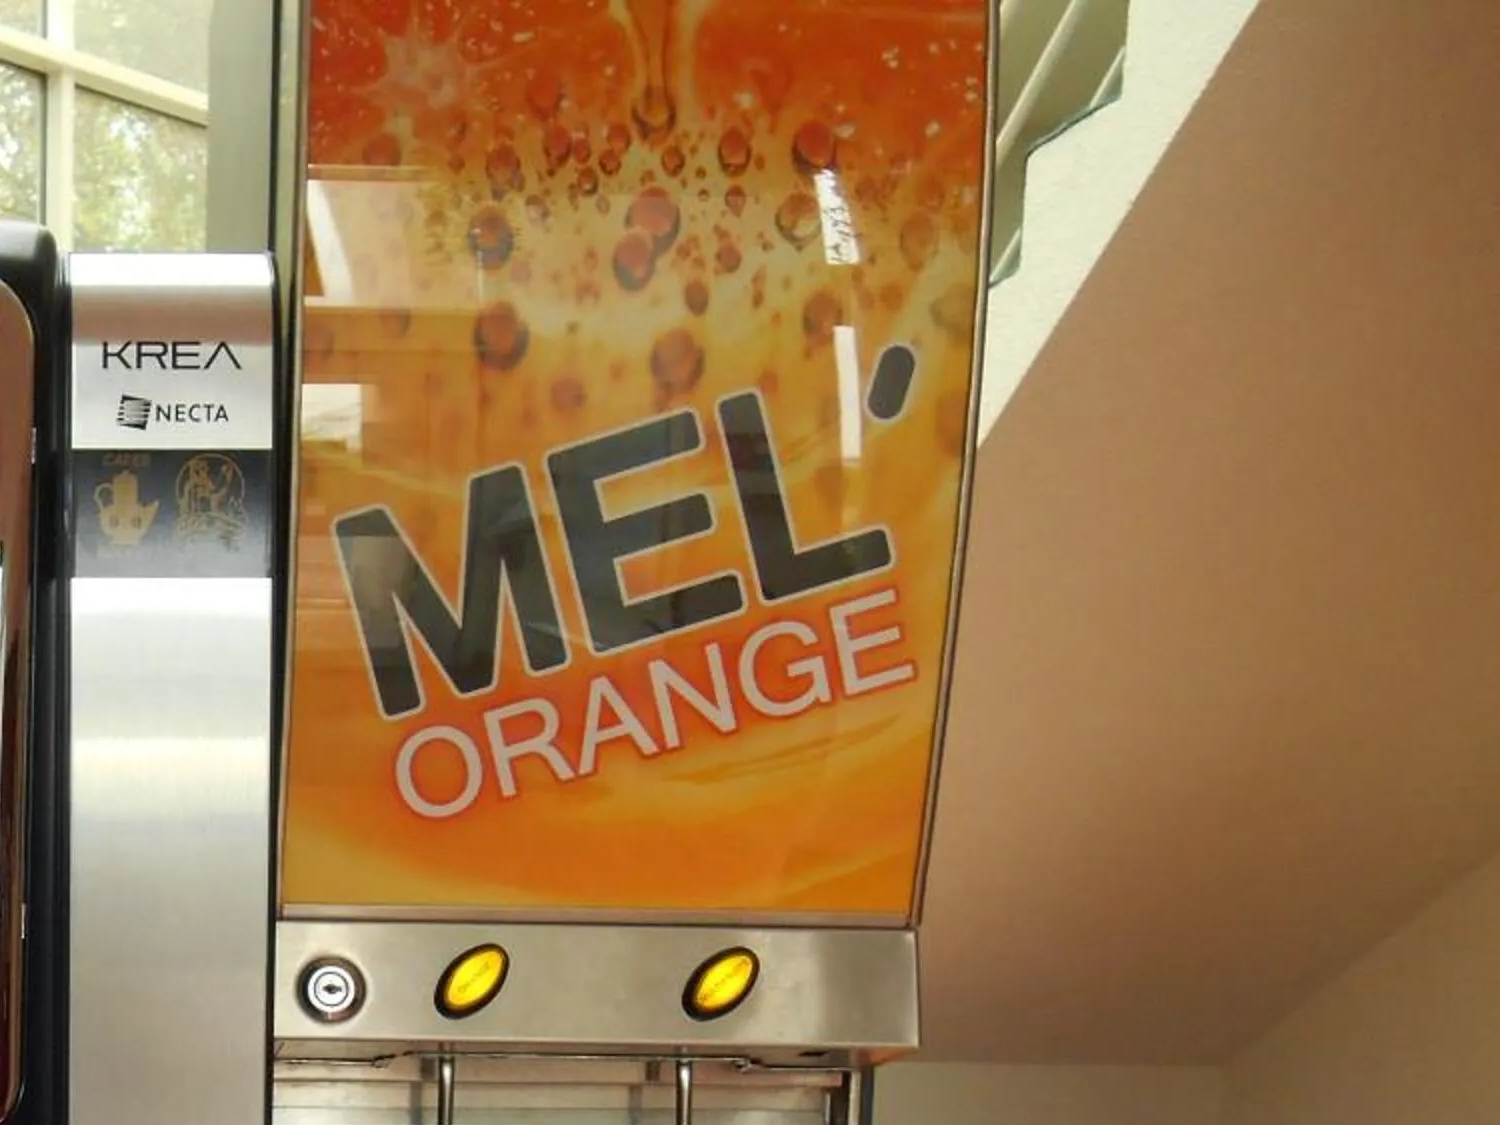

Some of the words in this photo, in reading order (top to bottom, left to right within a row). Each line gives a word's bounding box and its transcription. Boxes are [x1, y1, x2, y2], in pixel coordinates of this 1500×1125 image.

[101, 340, 243, 371] KREA
[155, 403, 230, 423] NECTA
[395, 588, 916, 819] ORANGE
